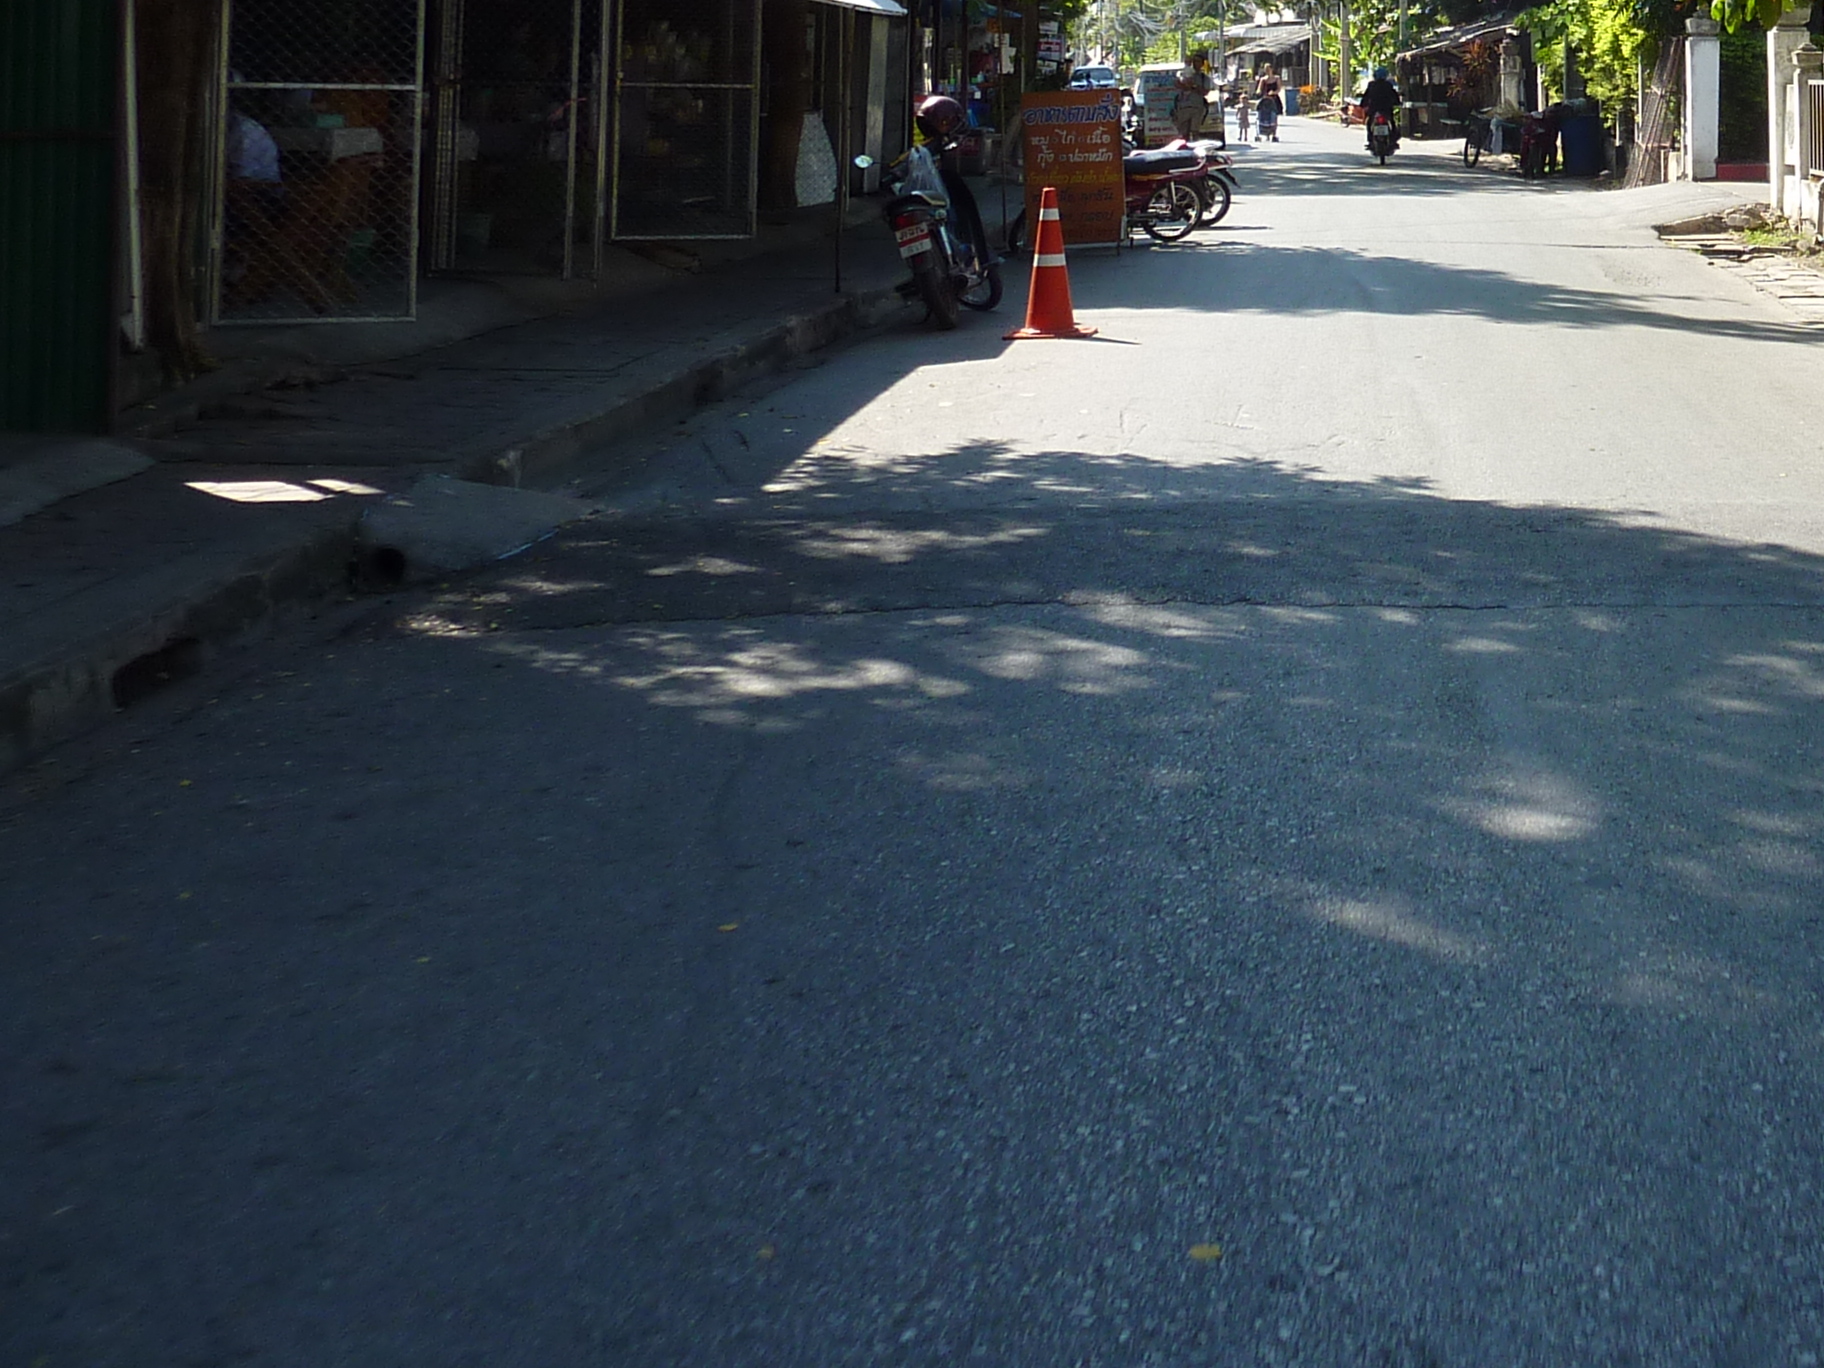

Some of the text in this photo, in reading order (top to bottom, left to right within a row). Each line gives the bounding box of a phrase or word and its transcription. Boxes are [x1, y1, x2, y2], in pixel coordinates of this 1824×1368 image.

[1023, 93, 1120, 125] อาหารตามสั่ง
